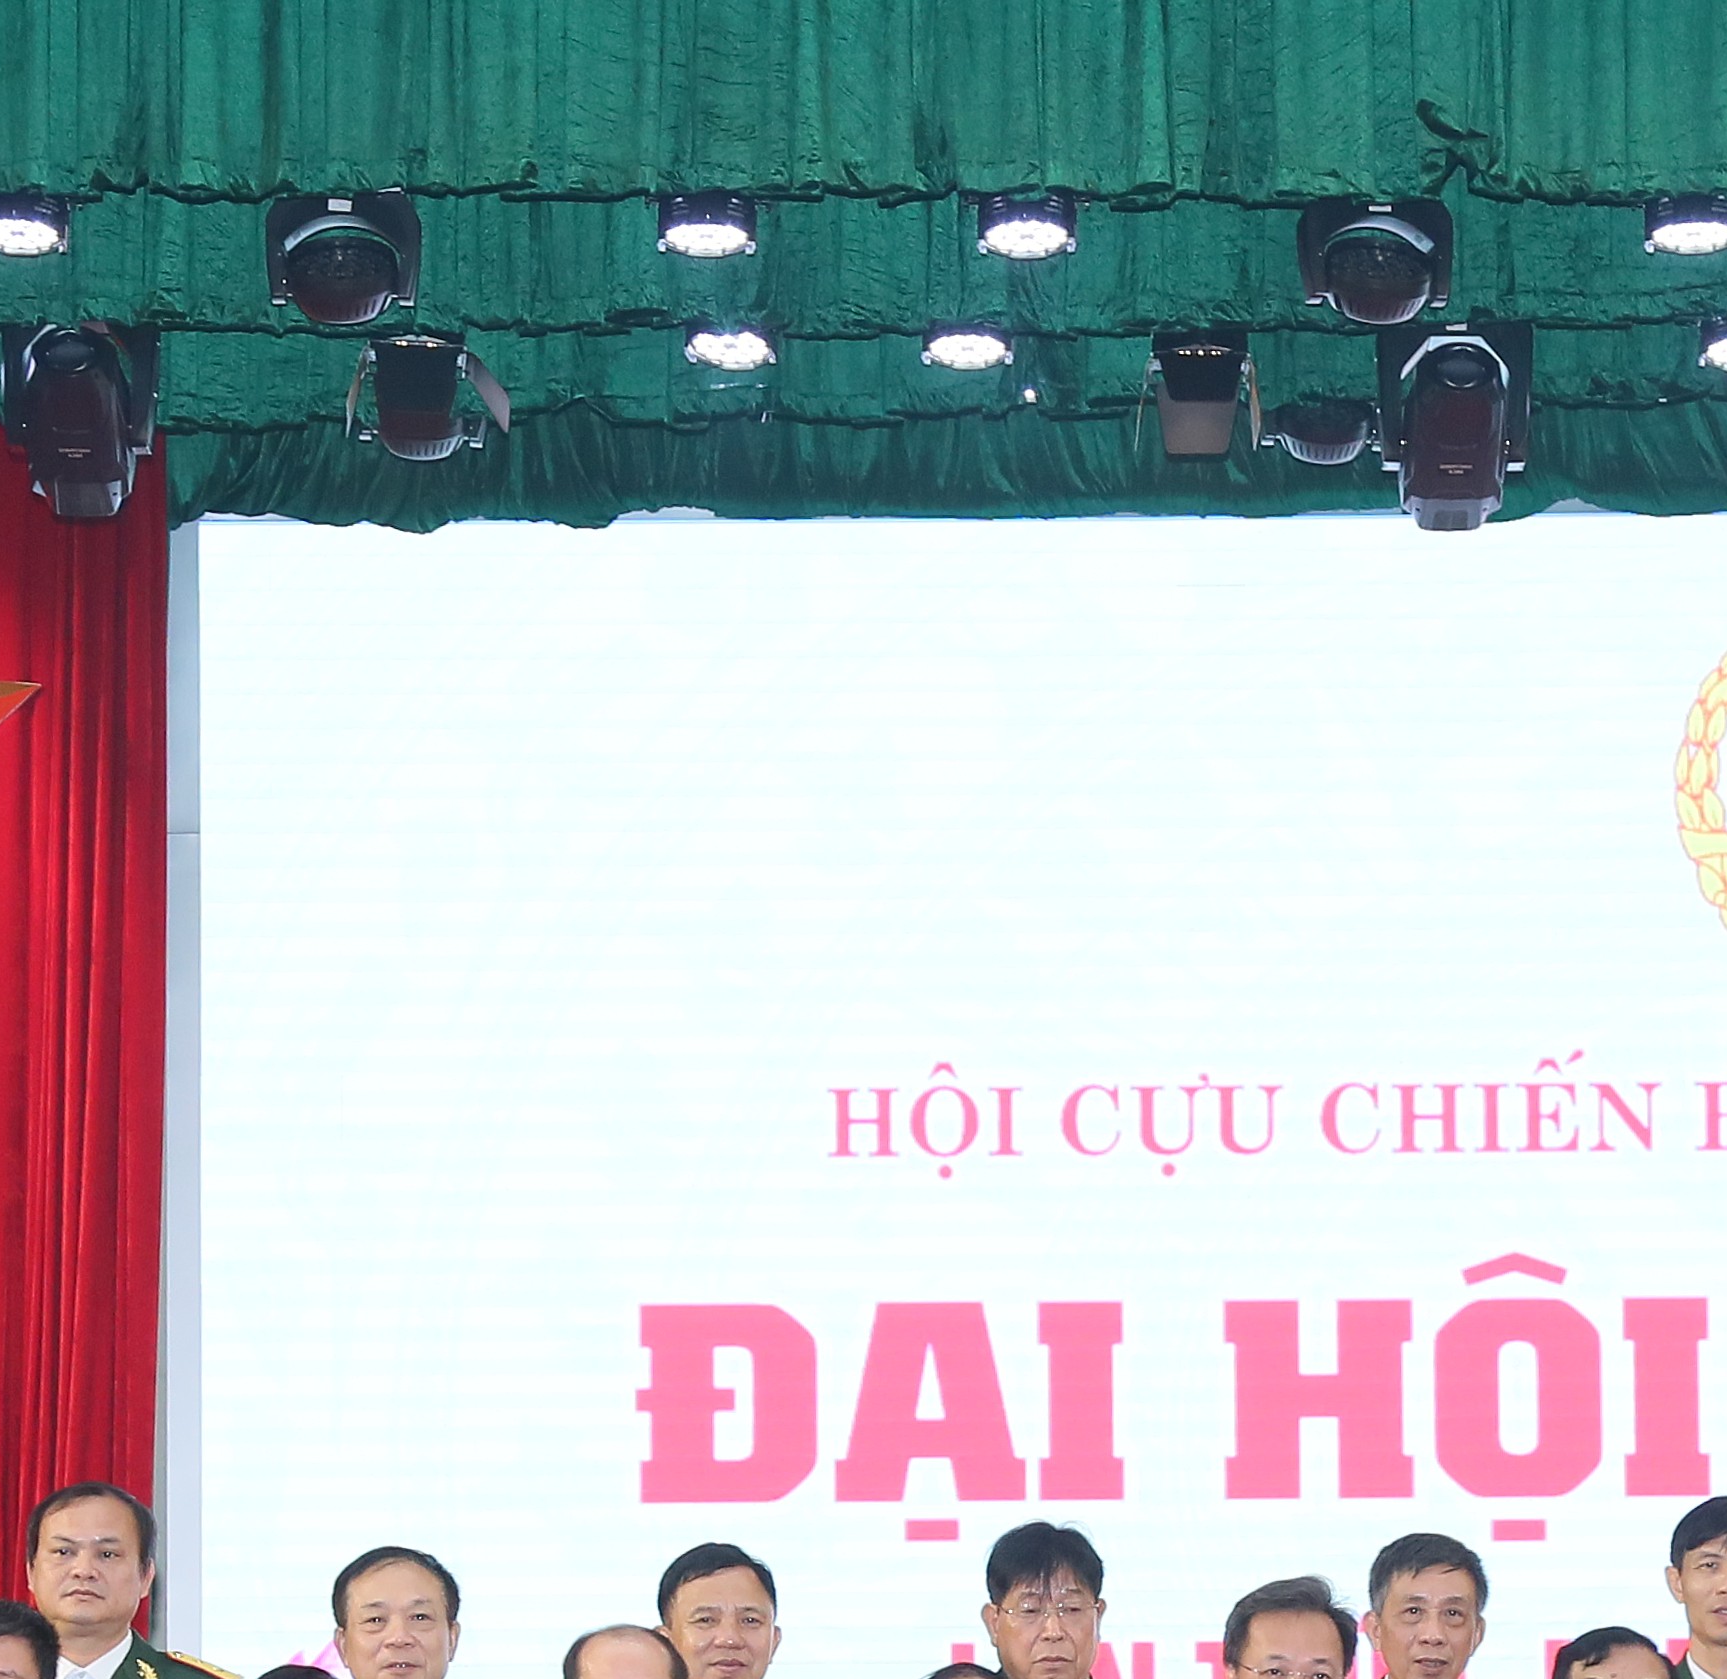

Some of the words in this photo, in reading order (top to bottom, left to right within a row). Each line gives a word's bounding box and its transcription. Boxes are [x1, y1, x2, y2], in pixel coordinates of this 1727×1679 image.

[831, 1061, 1021, 1179] HỘI
[1059, 1073, 1282, 1177] CỰU
[1319, 1049, 1660, 1155] CHIẾN
[637, 1300, 1125, 1543] ĐẠI
[1224, 1251, 1712, 1543] HỘI
